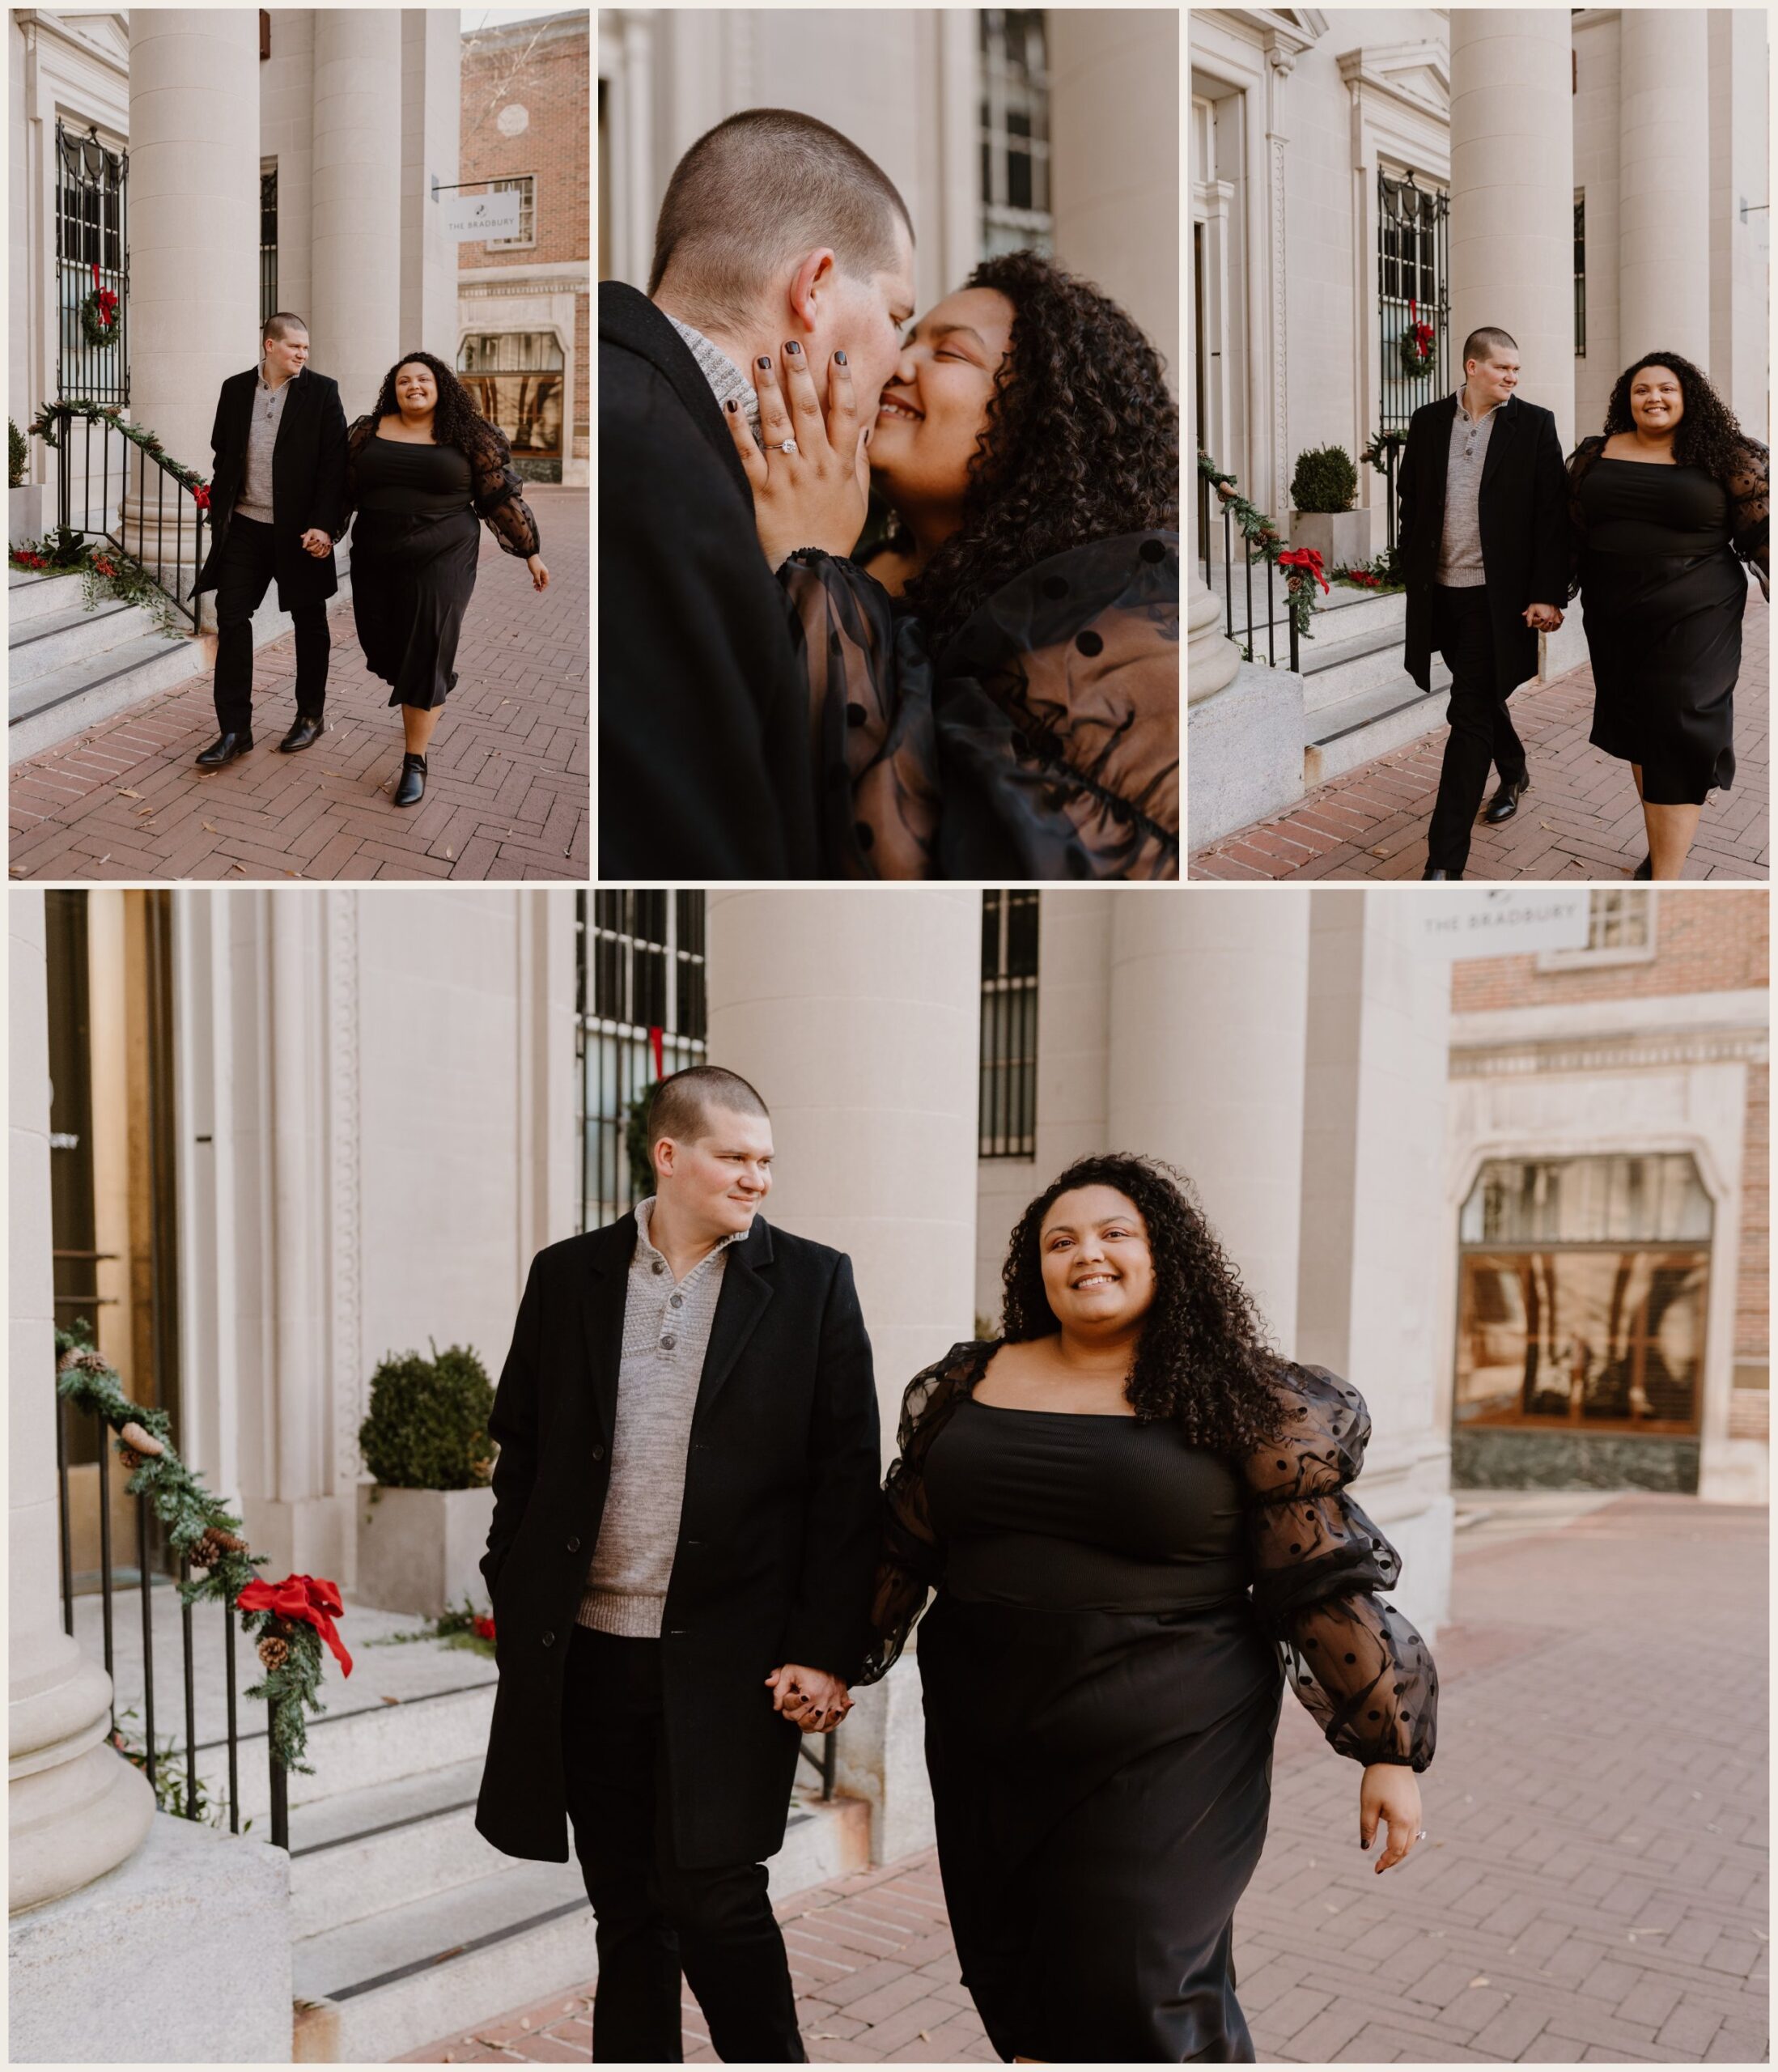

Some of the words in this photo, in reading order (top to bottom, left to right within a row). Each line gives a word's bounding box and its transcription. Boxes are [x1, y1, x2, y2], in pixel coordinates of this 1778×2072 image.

[468, 218, 515, 229] BRADBURY
[1424, 916, 1459, 932] THE
[1468, 903, 1576, 929] BRADBURY
